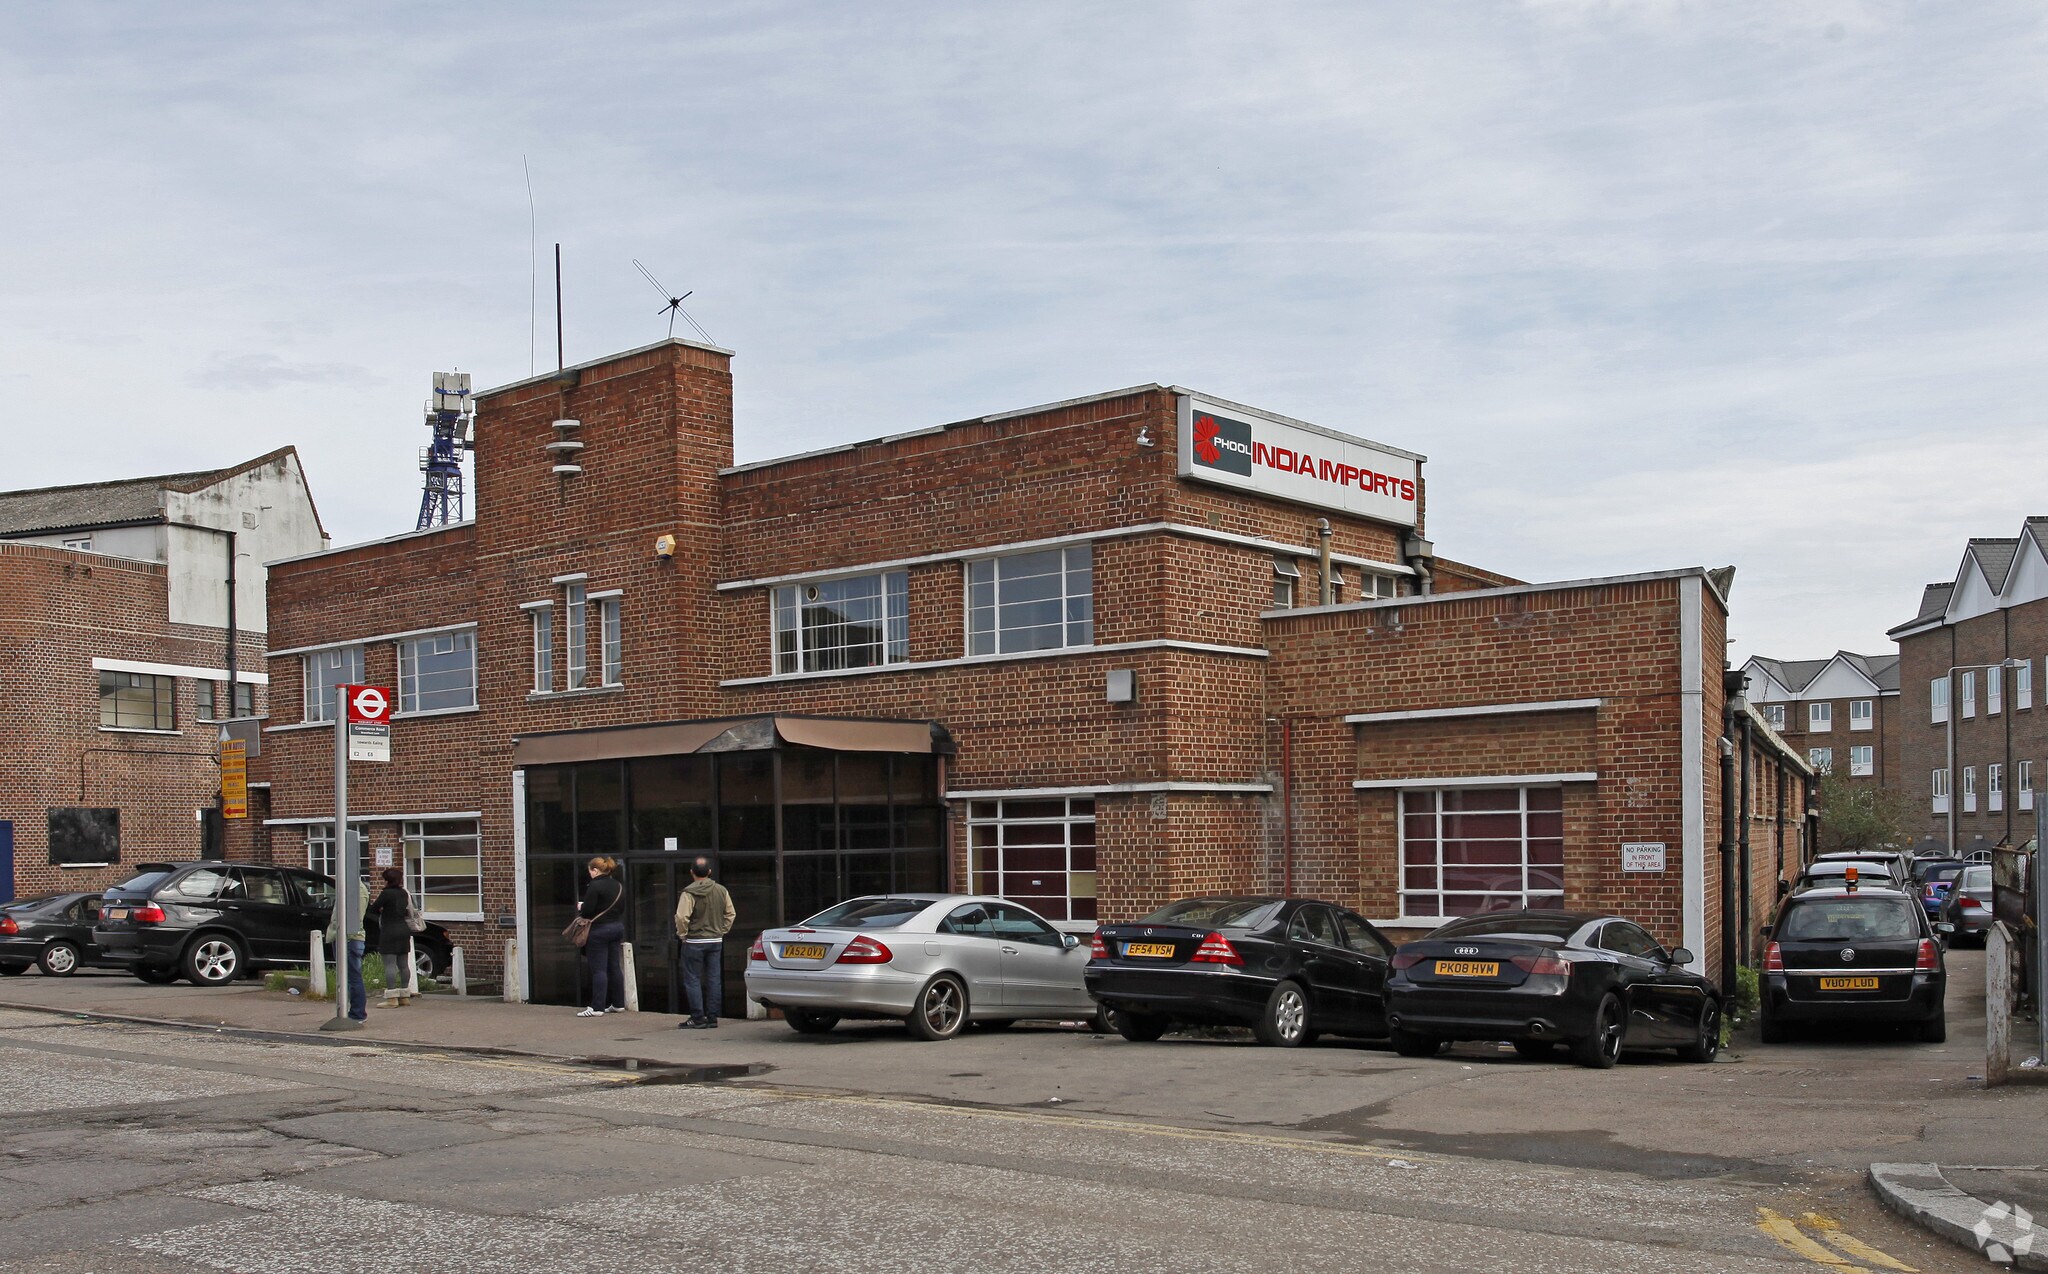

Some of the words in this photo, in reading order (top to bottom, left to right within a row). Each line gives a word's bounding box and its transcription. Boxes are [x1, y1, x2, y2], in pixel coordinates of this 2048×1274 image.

[1213, 436, 1252, 456] PHOOL
[1252, 440, 1317, 479] INDIA
[1318, 458, 1415, 502] IMPORTS
[784, 944, 805, 956] VA52
[1128, 944, 1153, 954] EF54
[1154, 944, 1173, 955] YSM
[1440, 962, 1469, 973] PK08
[1471, 963, 1494, 974] HVM
[1825, 979, 1851, 987] VU07
[1853, 979, 1874, 987] LUD
